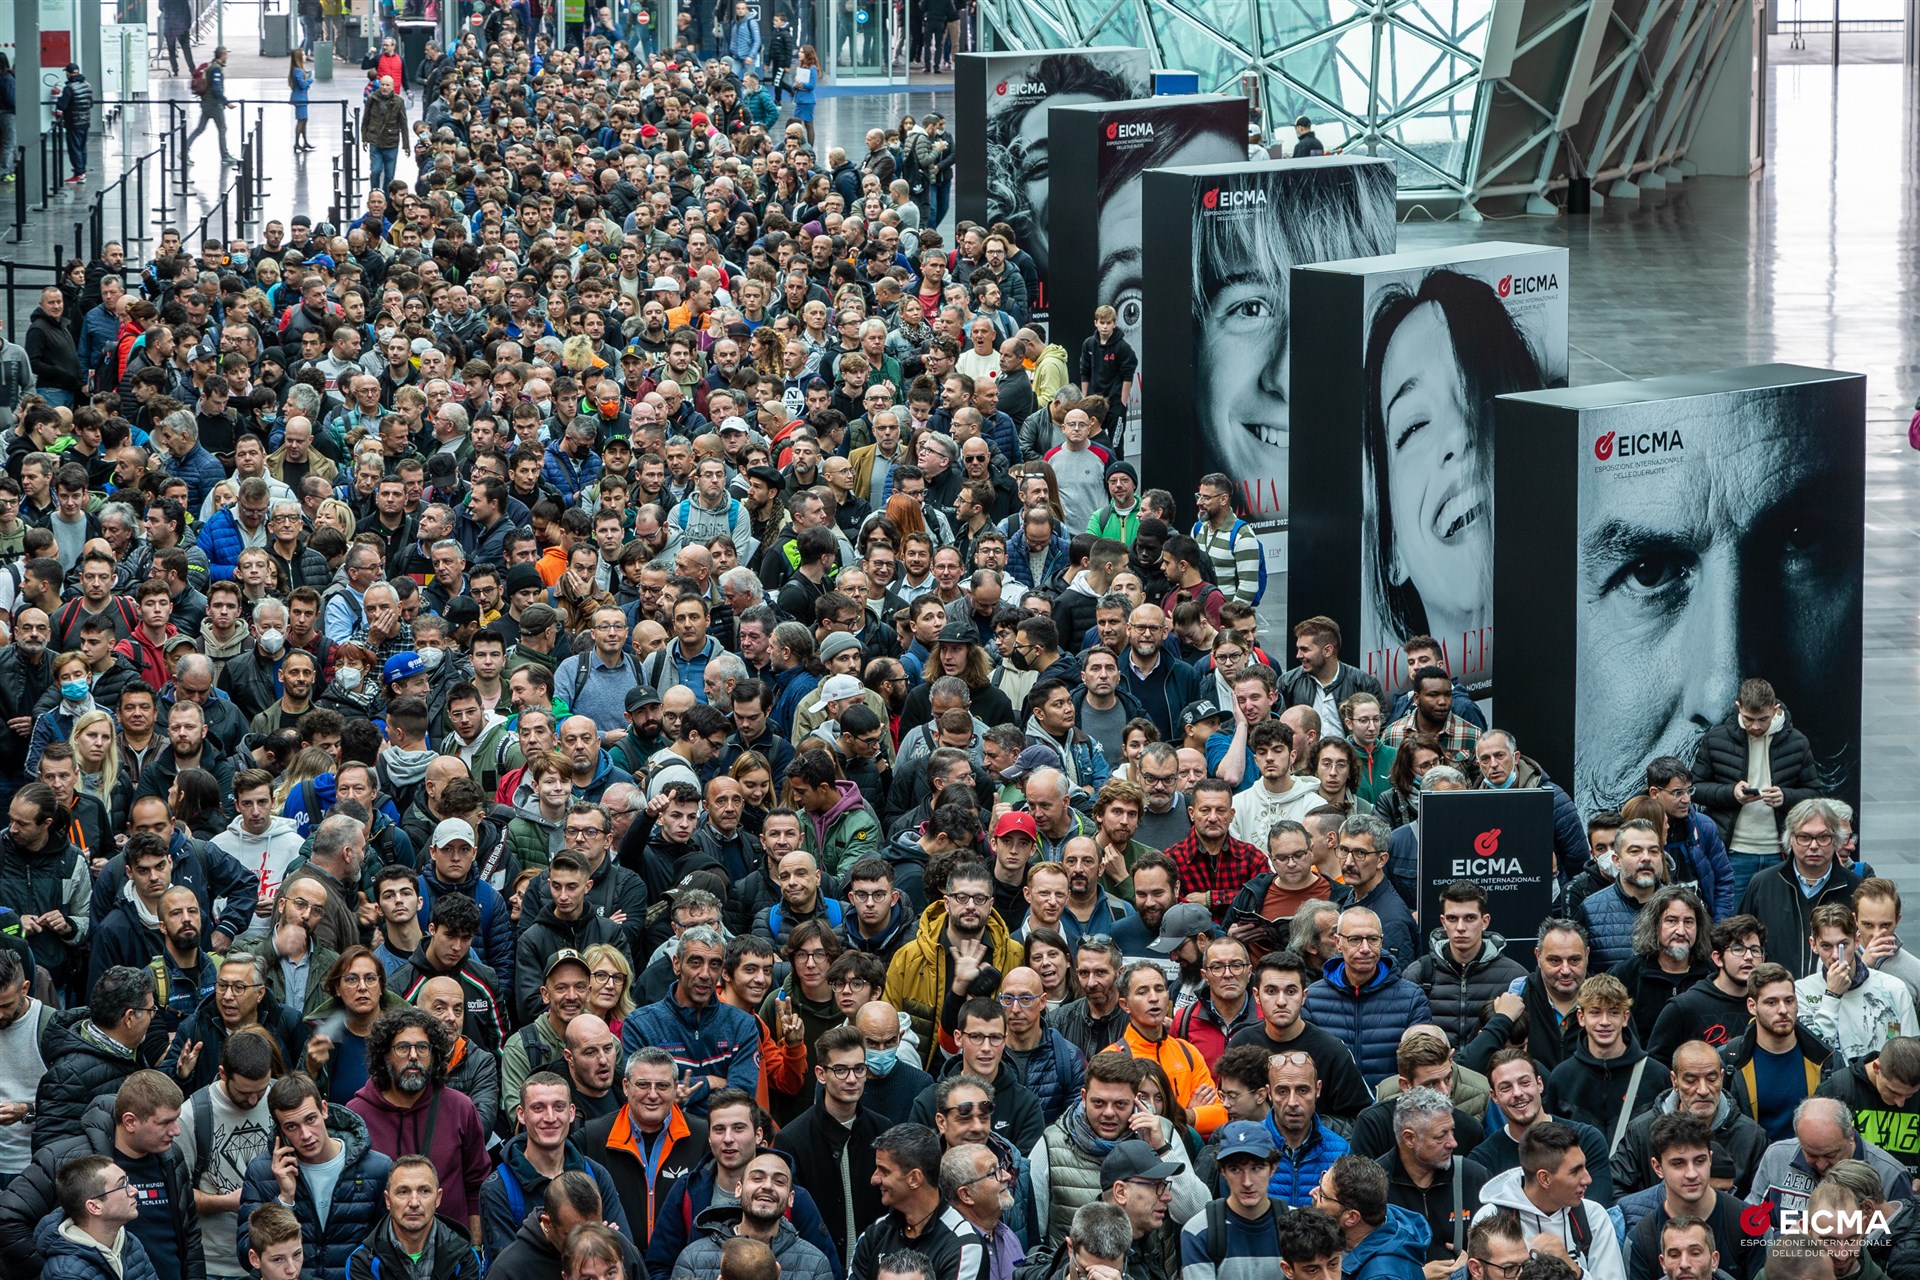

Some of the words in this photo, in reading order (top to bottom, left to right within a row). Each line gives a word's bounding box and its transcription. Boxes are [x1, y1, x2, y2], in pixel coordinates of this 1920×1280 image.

[1009, 82, 1047, 97] EICMA
[1118, 122, 1154, 138] EICMA
[1127, 136, 1154, 144] INTERNAZIONALE
[1220, 189, 1267, 207] EICMA
[1513, 273, 1559, 295] EICMA
[1523, 293, 1559, 304] INTERNAZIONALE
[1618, 429, 1684, 457] EICMA
[1594, 462, 1634, 474] ESPOSIZIONE
[1634, 455, 1685, 469] INTERNAZIONALE
[1613, 470, 1632, 480] DELLE
[1645, 467, 1665, 476] RUOTE
[1452, 857, 1524, 876] EICMA
[1481, 875, 1541, 884] INTERNAZIONALE
[1494, 883, 1519, 891] RUOTE
[466, 998, 488, 1010] aprilia
